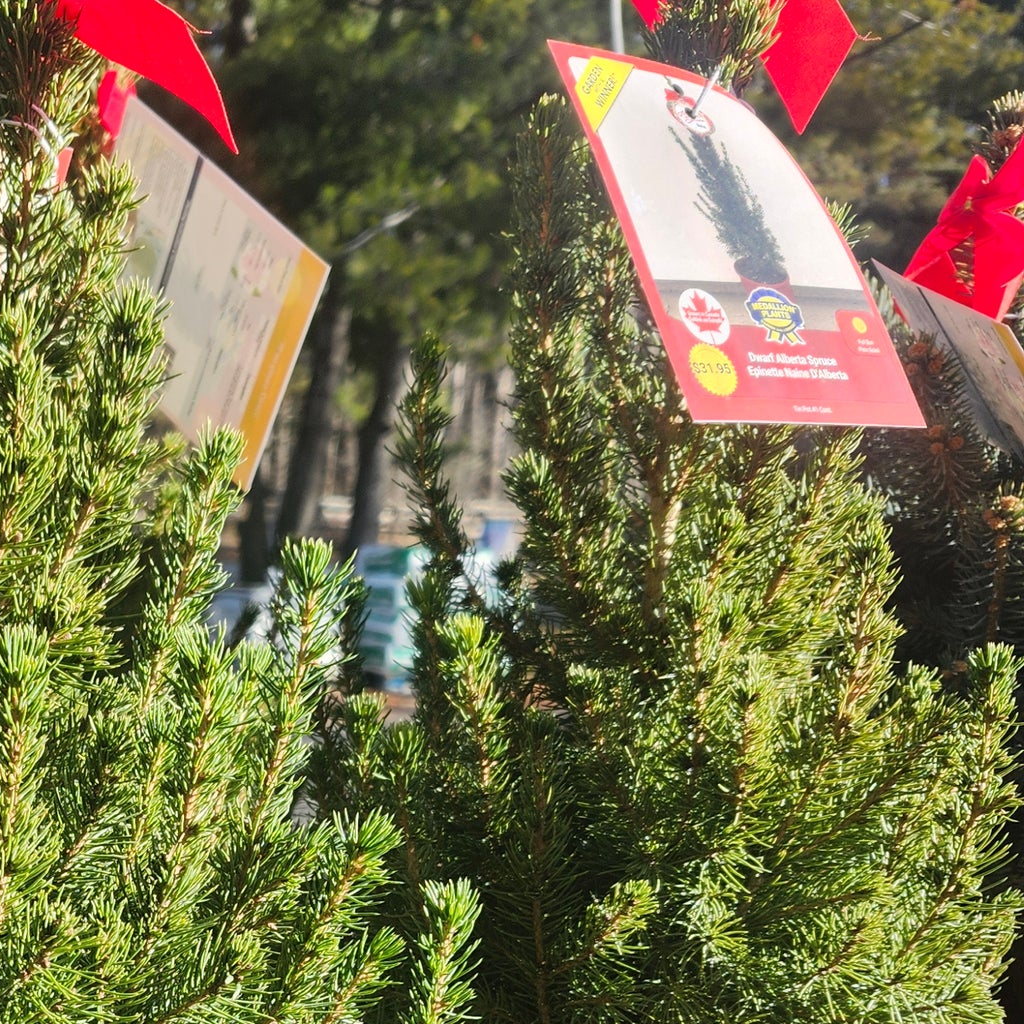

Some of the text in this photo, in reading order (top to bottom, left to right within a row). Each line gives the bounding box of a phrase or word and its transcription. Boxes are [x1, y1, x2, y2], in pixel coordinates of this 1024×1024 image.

[582, 64, 603, 95] GARDEN
[751, 302, 795, 314] MEDALLION
[760, 310, 791, 320] PLANTS
[747, 352, 838, 367] Dwarf Alberta Spruce
[692, 362, 731, 374] $31.95
[747, 365, 849, 381] Epinette Naine D'Alberta
